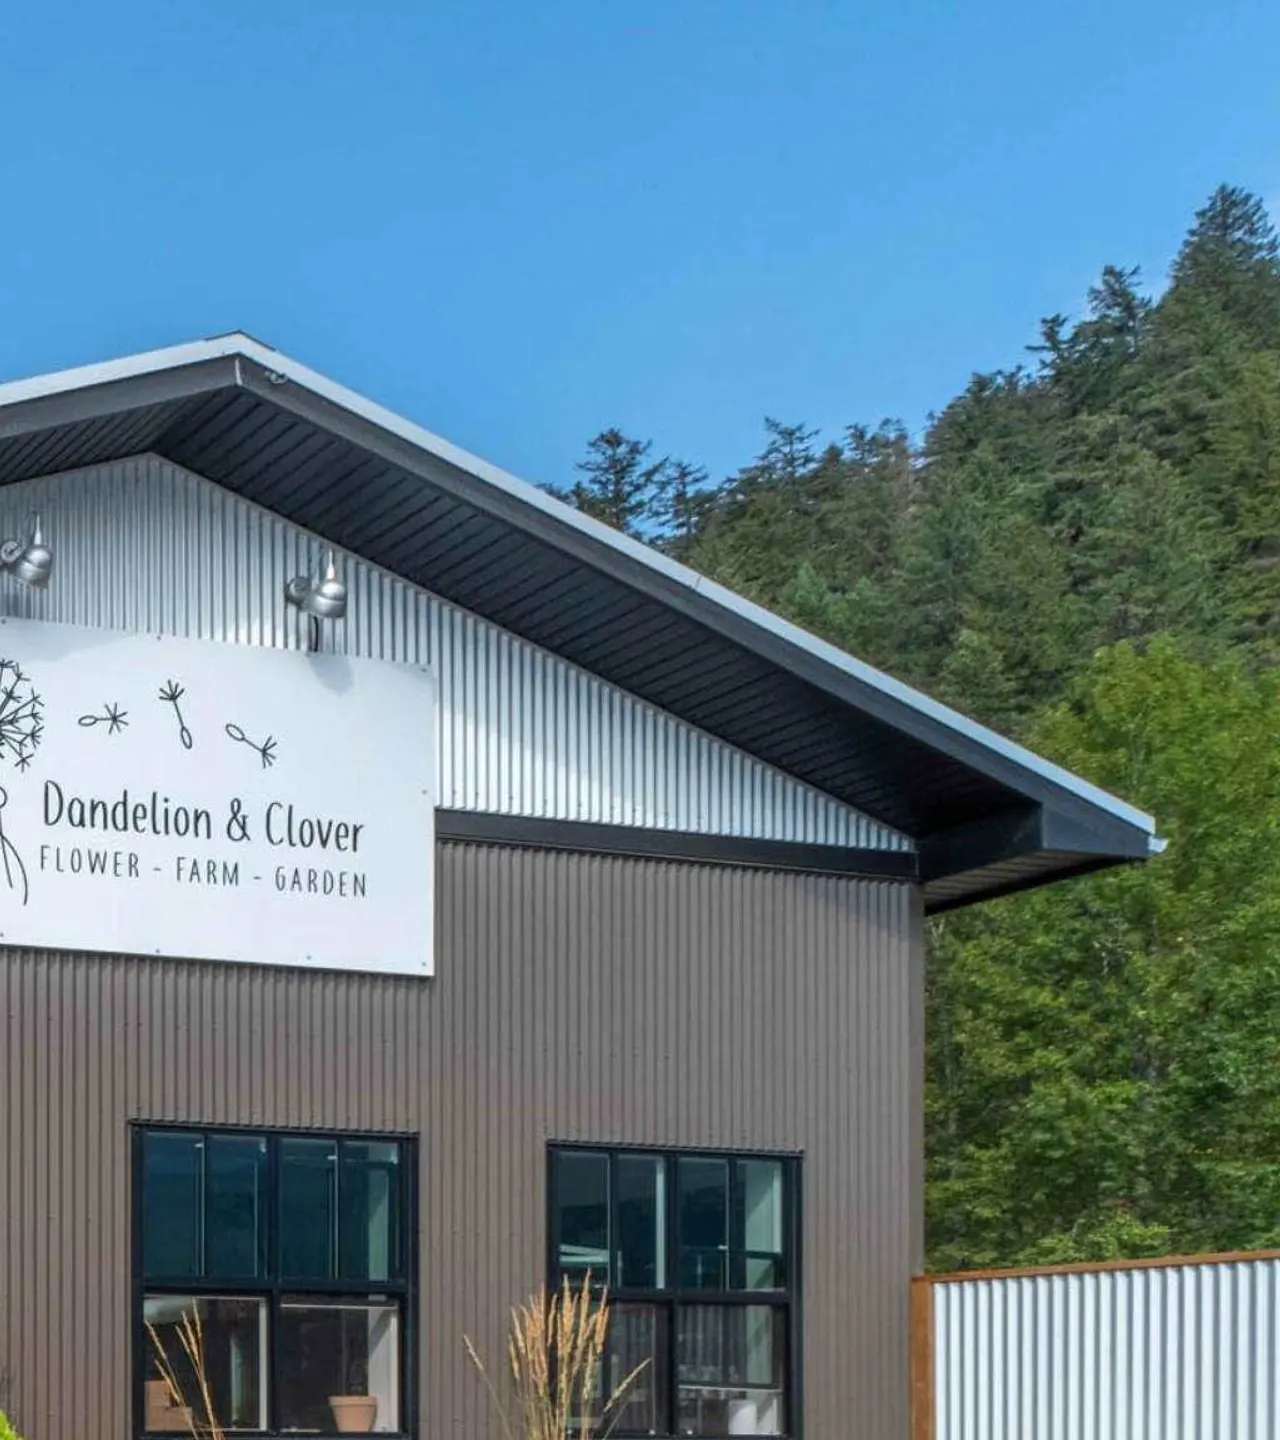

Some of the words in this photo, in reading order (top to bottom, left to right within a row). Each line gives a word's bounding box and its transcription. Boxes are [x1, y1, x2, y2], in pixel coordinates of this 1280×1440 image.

[43, 779, 212, 840] Dandelion
[226, 797, 252, 843] &
[265, 801, 365, 854] Clover
[39, 844, 140, 879] FLOWER
[175, 855, 241, 887] FARM
[274, 865, 367, 898] GARDEN
